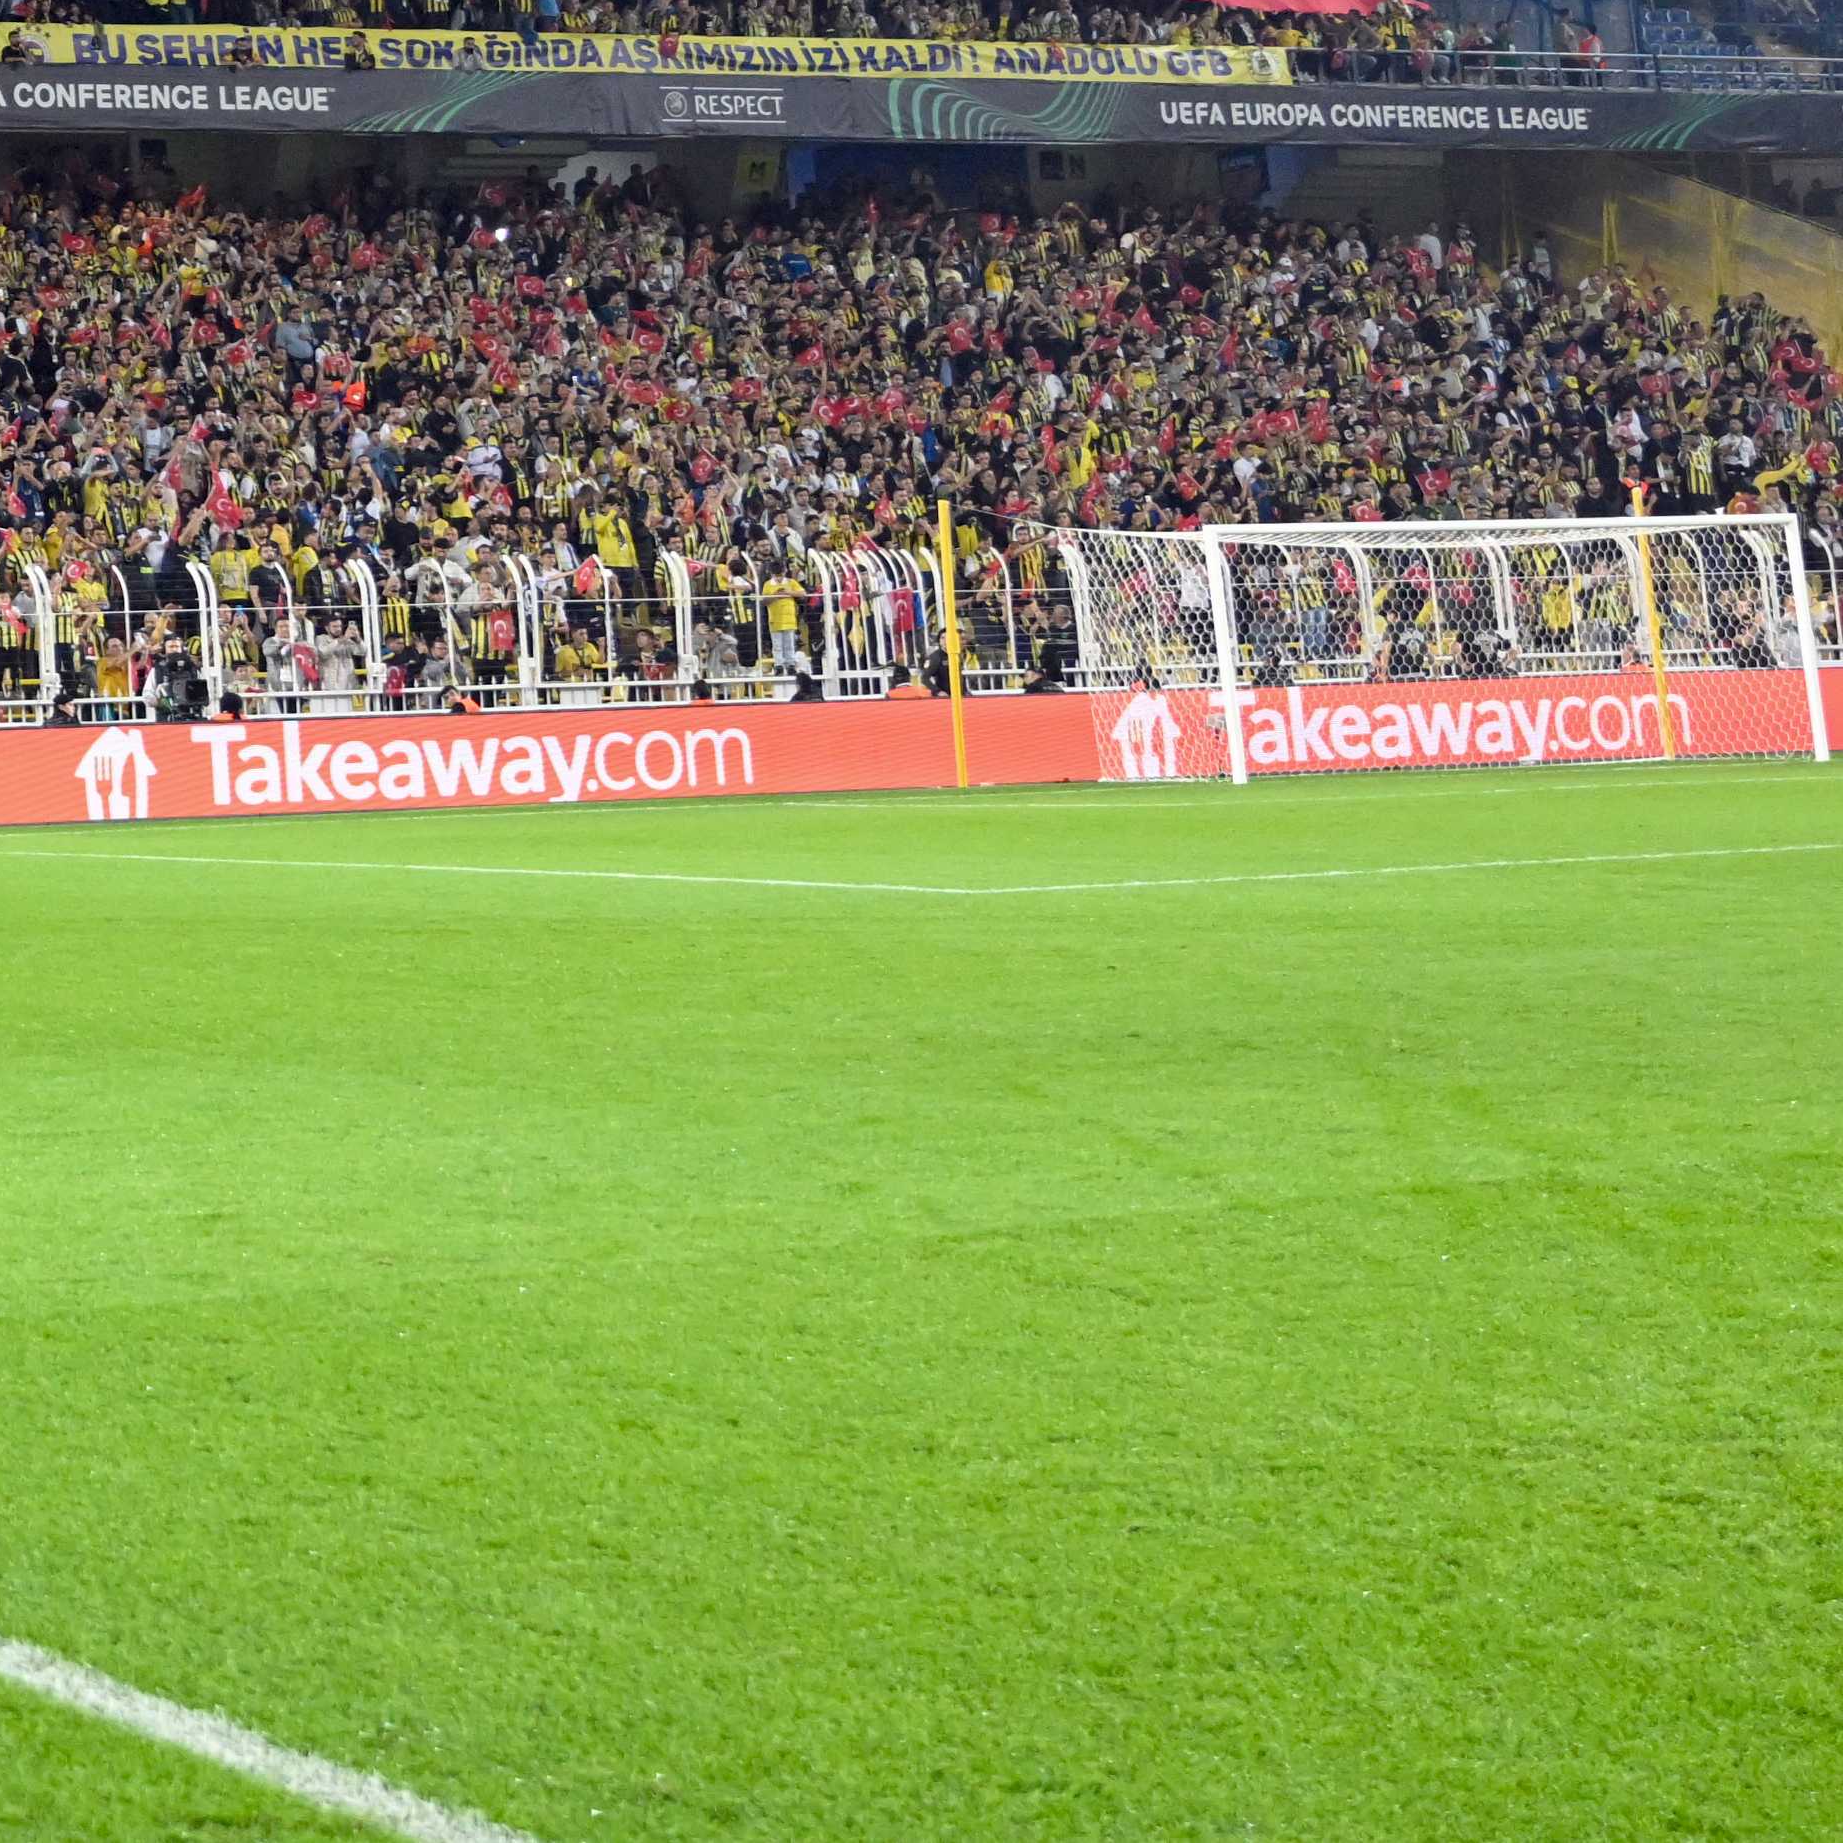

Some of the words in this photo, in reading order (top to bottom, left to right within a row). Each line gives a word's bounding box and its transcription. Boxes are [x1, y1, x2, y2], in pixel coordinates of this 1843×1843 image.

[71, 33, 131, 66] BU
[993, 44, 1157, 77] ANADOLU
[1167, 49, 1233, 78] GFB
[13, 82, 209, 111] CONFERENCE
[694, 95, 783, 118] RESPECT
[1160, 101, 1225, 126] UEFA
[1232, 103, 1324, 128] EUROPA
[1331, 104, 1490, 130] CONFERENCE
[190, 720, 755, 805] Takeaway.com
